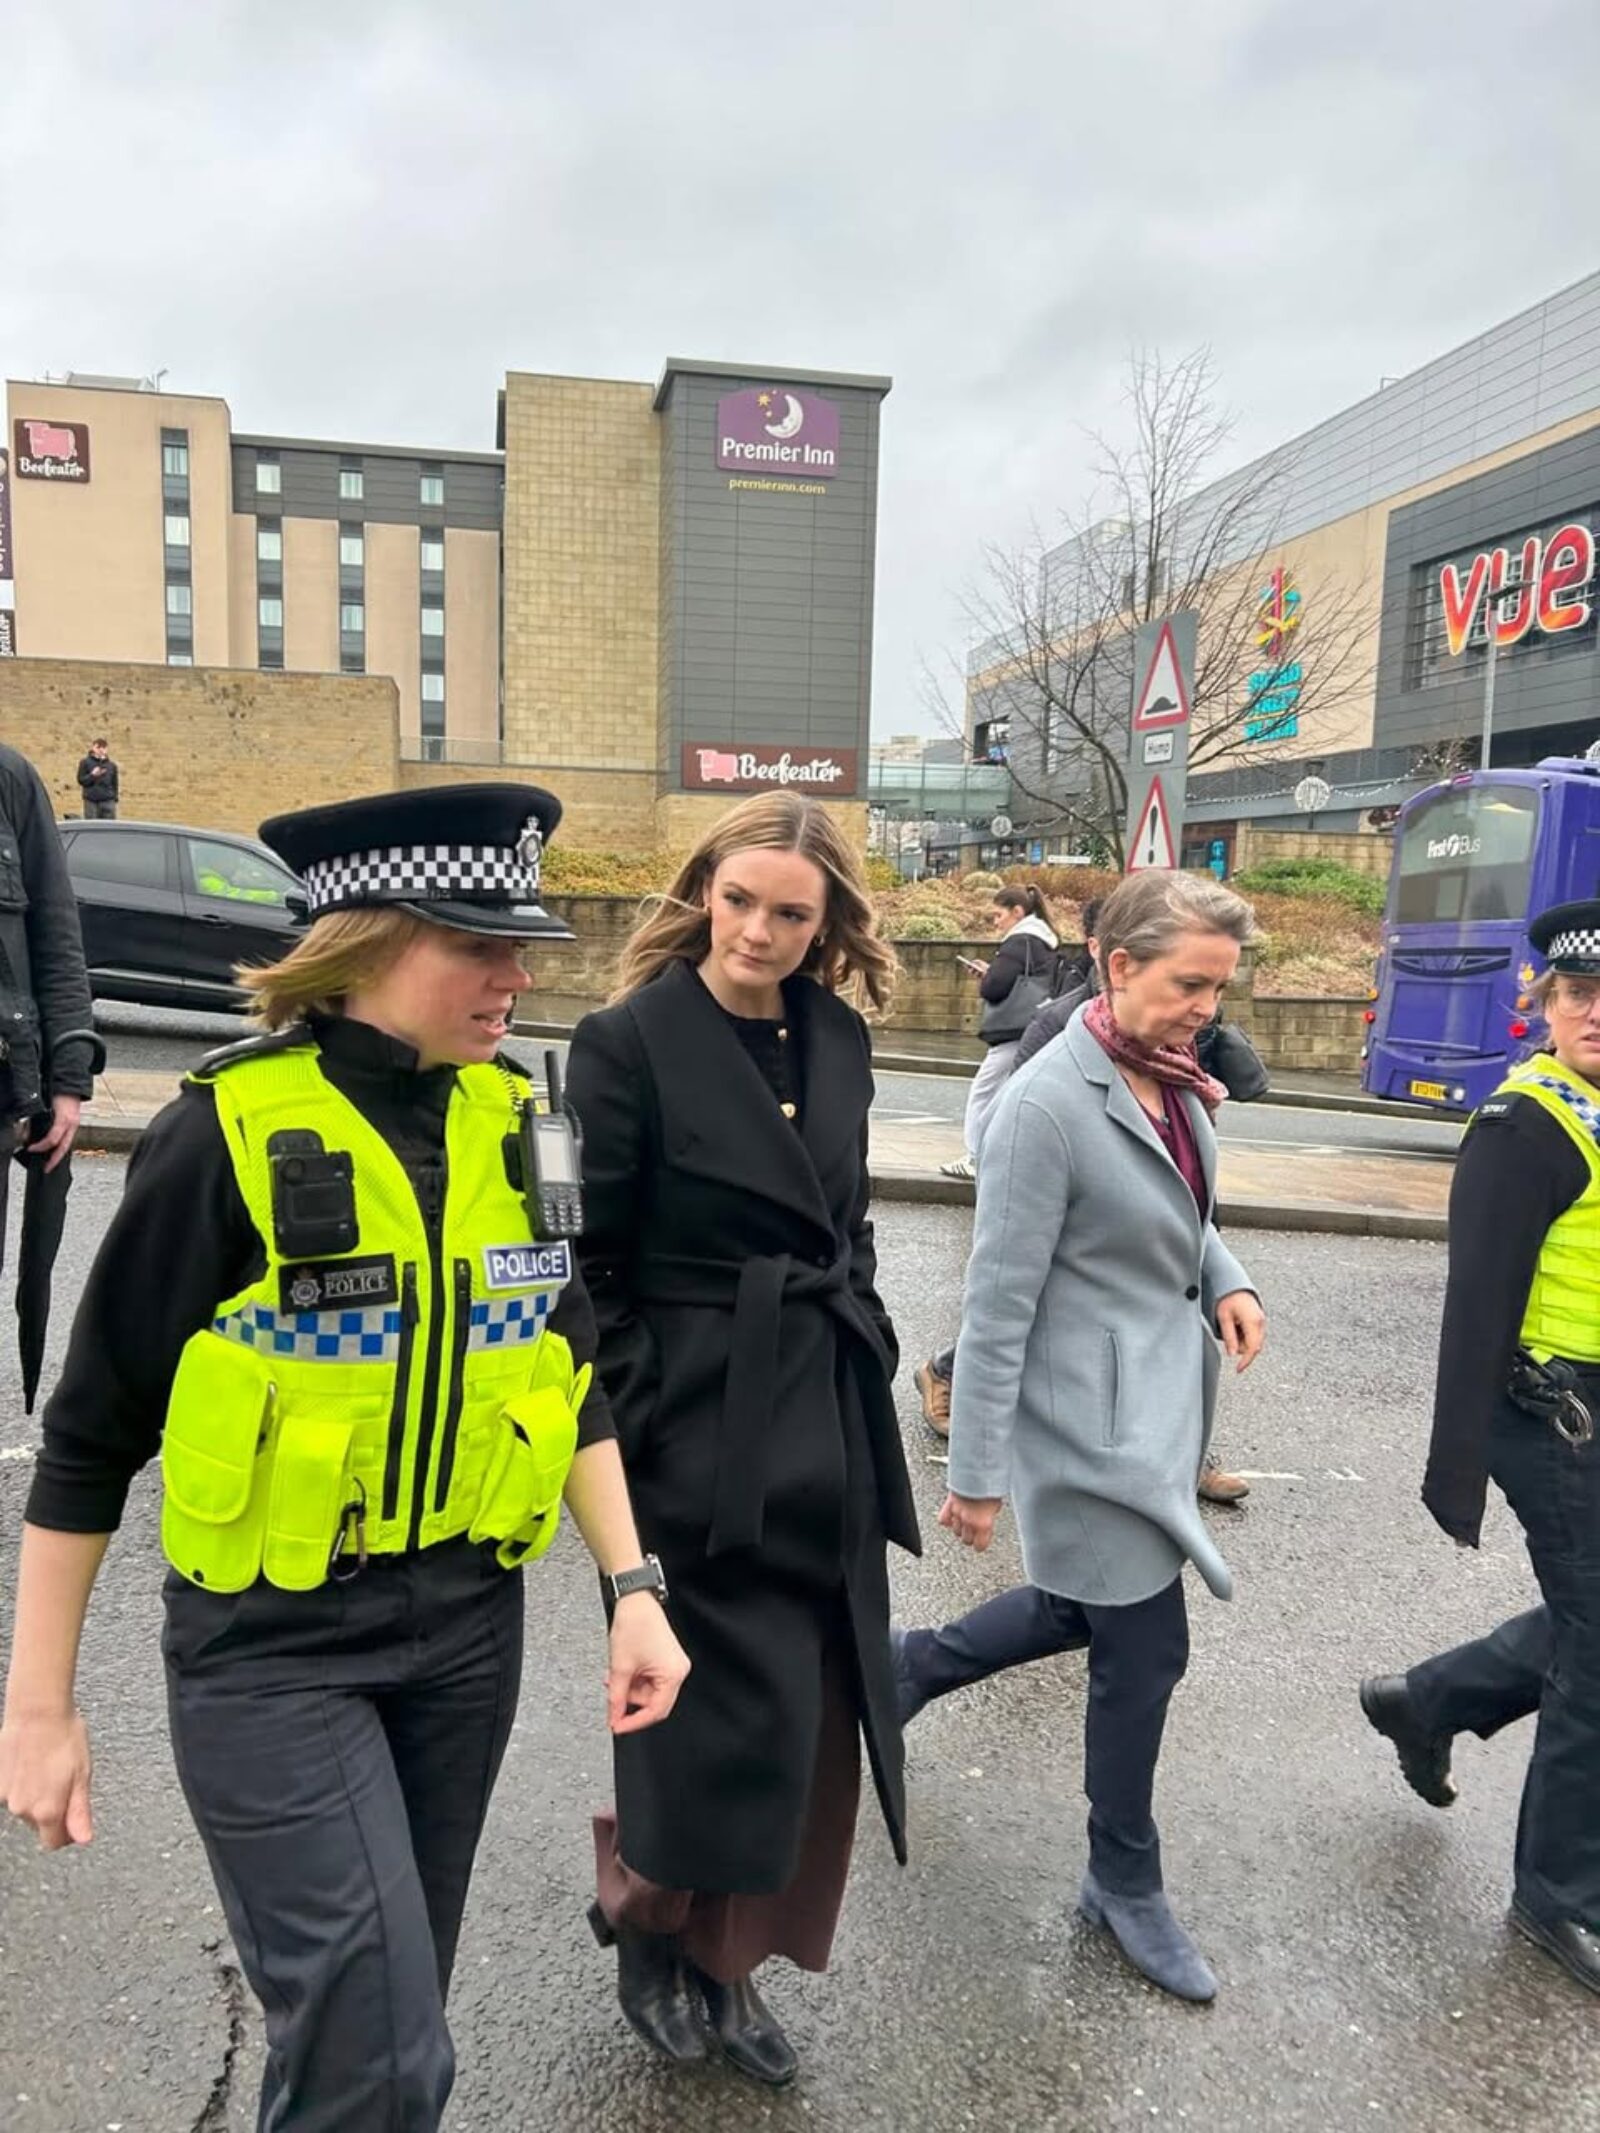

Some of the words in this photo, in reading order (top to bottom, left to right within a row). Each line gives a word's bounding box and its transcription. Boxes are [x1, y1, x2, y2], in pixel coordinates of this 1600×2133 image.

[722, 437, 801, 463] Premier
[803, 442, 835, 465] Inn
[18, 456, 85, 477] Beefeater
[729, 479, 826, 495] premierinn.com
[738, 752, 844, 785] Beefeater
[1460, 835, 1481, 855] Bus
[491, 1251, 563, 1279] POLICE
[325, 1273, 388, 1298] POLICE
